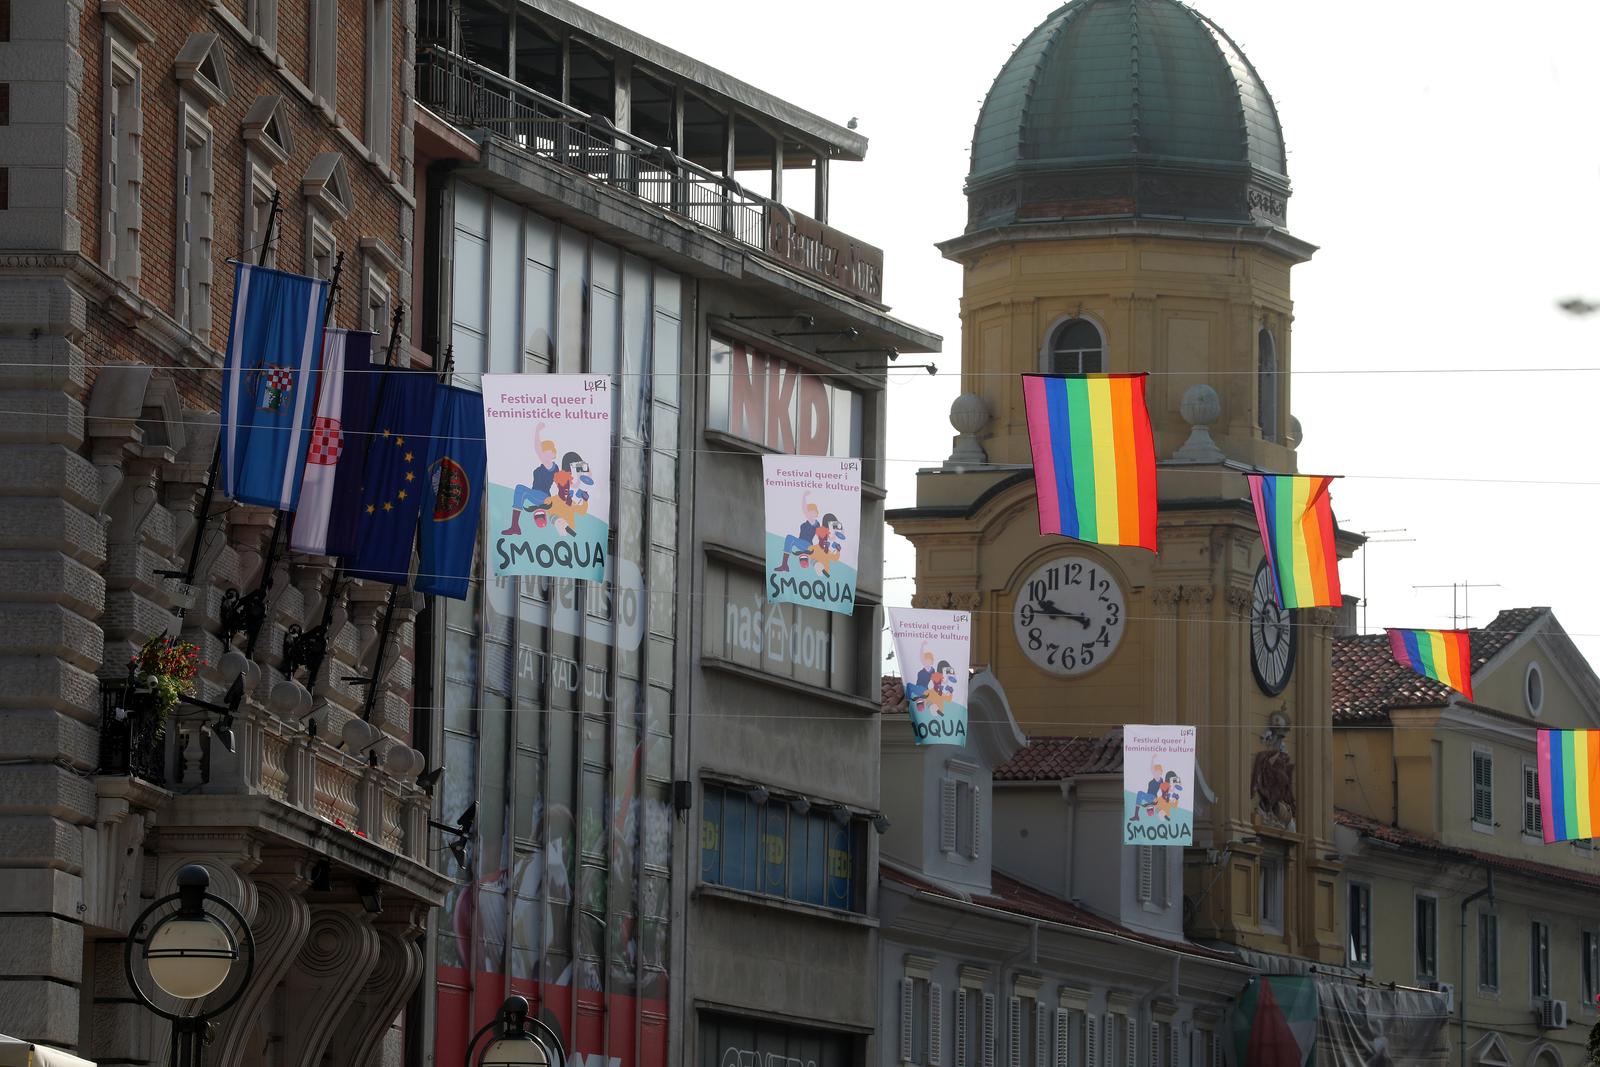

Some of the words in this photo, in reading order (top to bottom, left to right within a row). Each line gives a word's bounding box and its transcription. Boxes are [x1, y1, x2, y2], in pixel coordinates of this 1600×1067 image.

[500, 393, 547, 405] Festival
[551, 397, 586, 406] queer
[590, 394, 594, 405] i
[732, 341, 830, 456] NKD
[487, 407, 561, 419] feminističke
[565, 408, 609, 420] kulture
[765, 479, 823, 489] feminističke
[826, 481, 860, 492] kulture
[776, 469, 812, 478] Festival
[815, 472, 842, 481] queer
[495, 538, 605, 570] SMOQUA
[1046, 568, 1059, 590] 11
[1064, 563, 1082, 585] 12
[1088, 568, 1096, 591] 1
[770, 573, 853, 603] SMOQUA
[1028, 580, 1047, 602] 10
[1098, 580, 1110, 602] 2
[1021, 604, 1034, 627] 9
[1106, 603, 1119, 626] 3
[900, 621, 929, 629] Festival
[932, 624, 955, 632] queer
[941, 632, 969, 641] kulture
[1096, 626, 1111, 647] 4
[1028, 628, 1042, 650] 8
[1046, 643, 1060, 665] 7
[1062, 647, 1076, 670] 6
[1080, 642, 1095, 665] 5
[1127, 822, 1191, 840] SMOQUA
